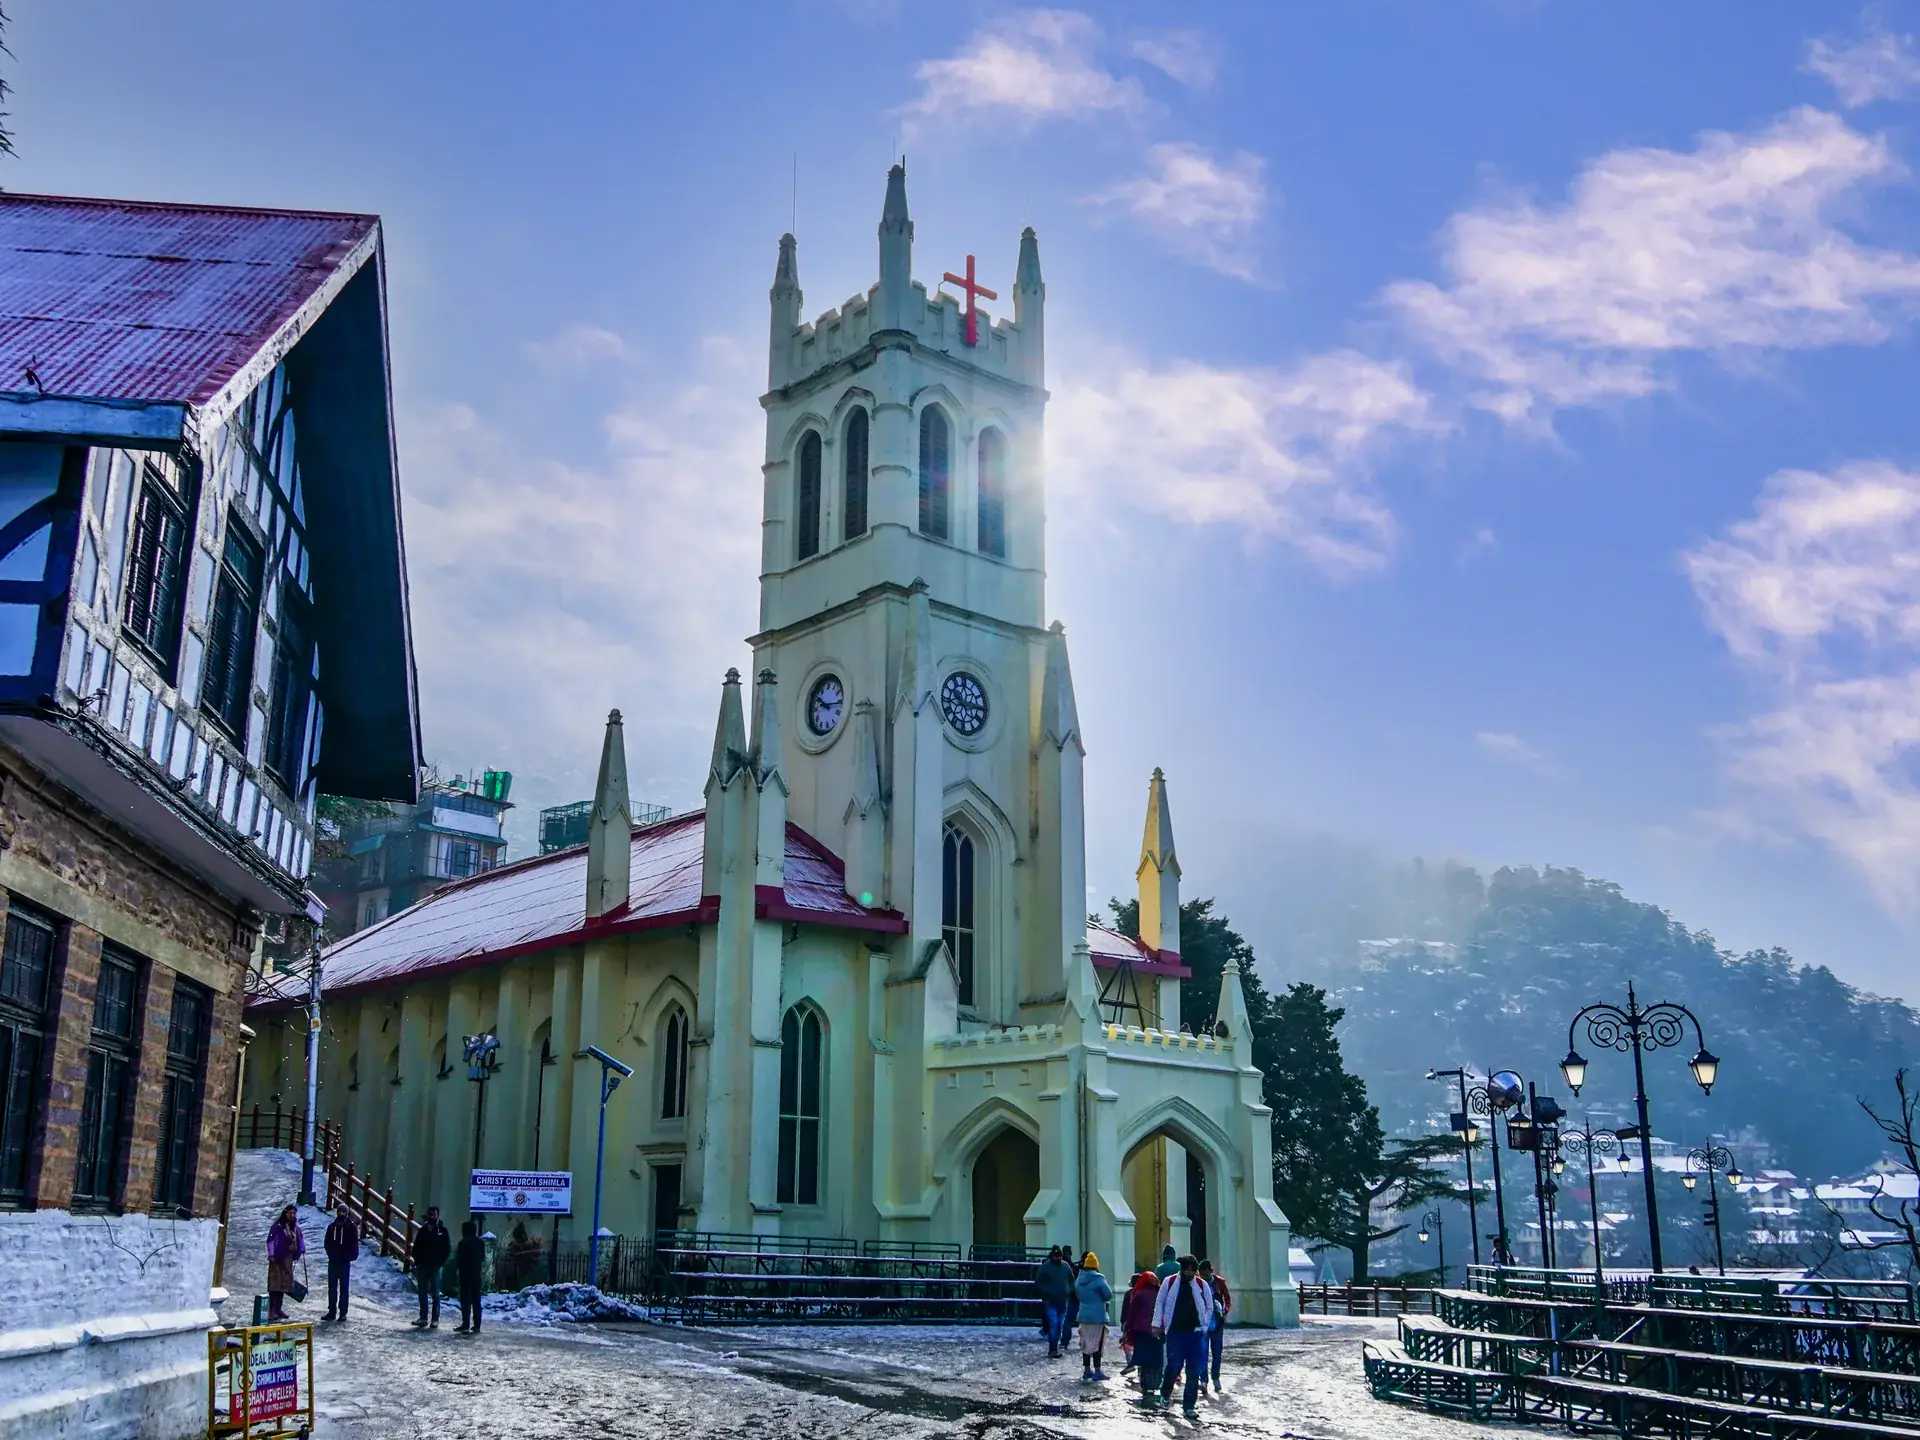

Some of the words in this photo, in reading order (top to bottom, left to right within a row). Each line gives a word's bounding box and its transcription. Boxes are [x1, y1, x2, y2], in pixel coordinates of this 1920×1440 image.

[506, 1177, 536, 1185] CHURCH
[538, 1178, 565, 1186] SHIMLA
[268, 1348, 293, 1363] PARKING
[257, 1372, 276, 1386] SHIMLA
[277, 1368, 293, 1381] POLICE
[266, 1384, 294, 1402] JEWELLERS
